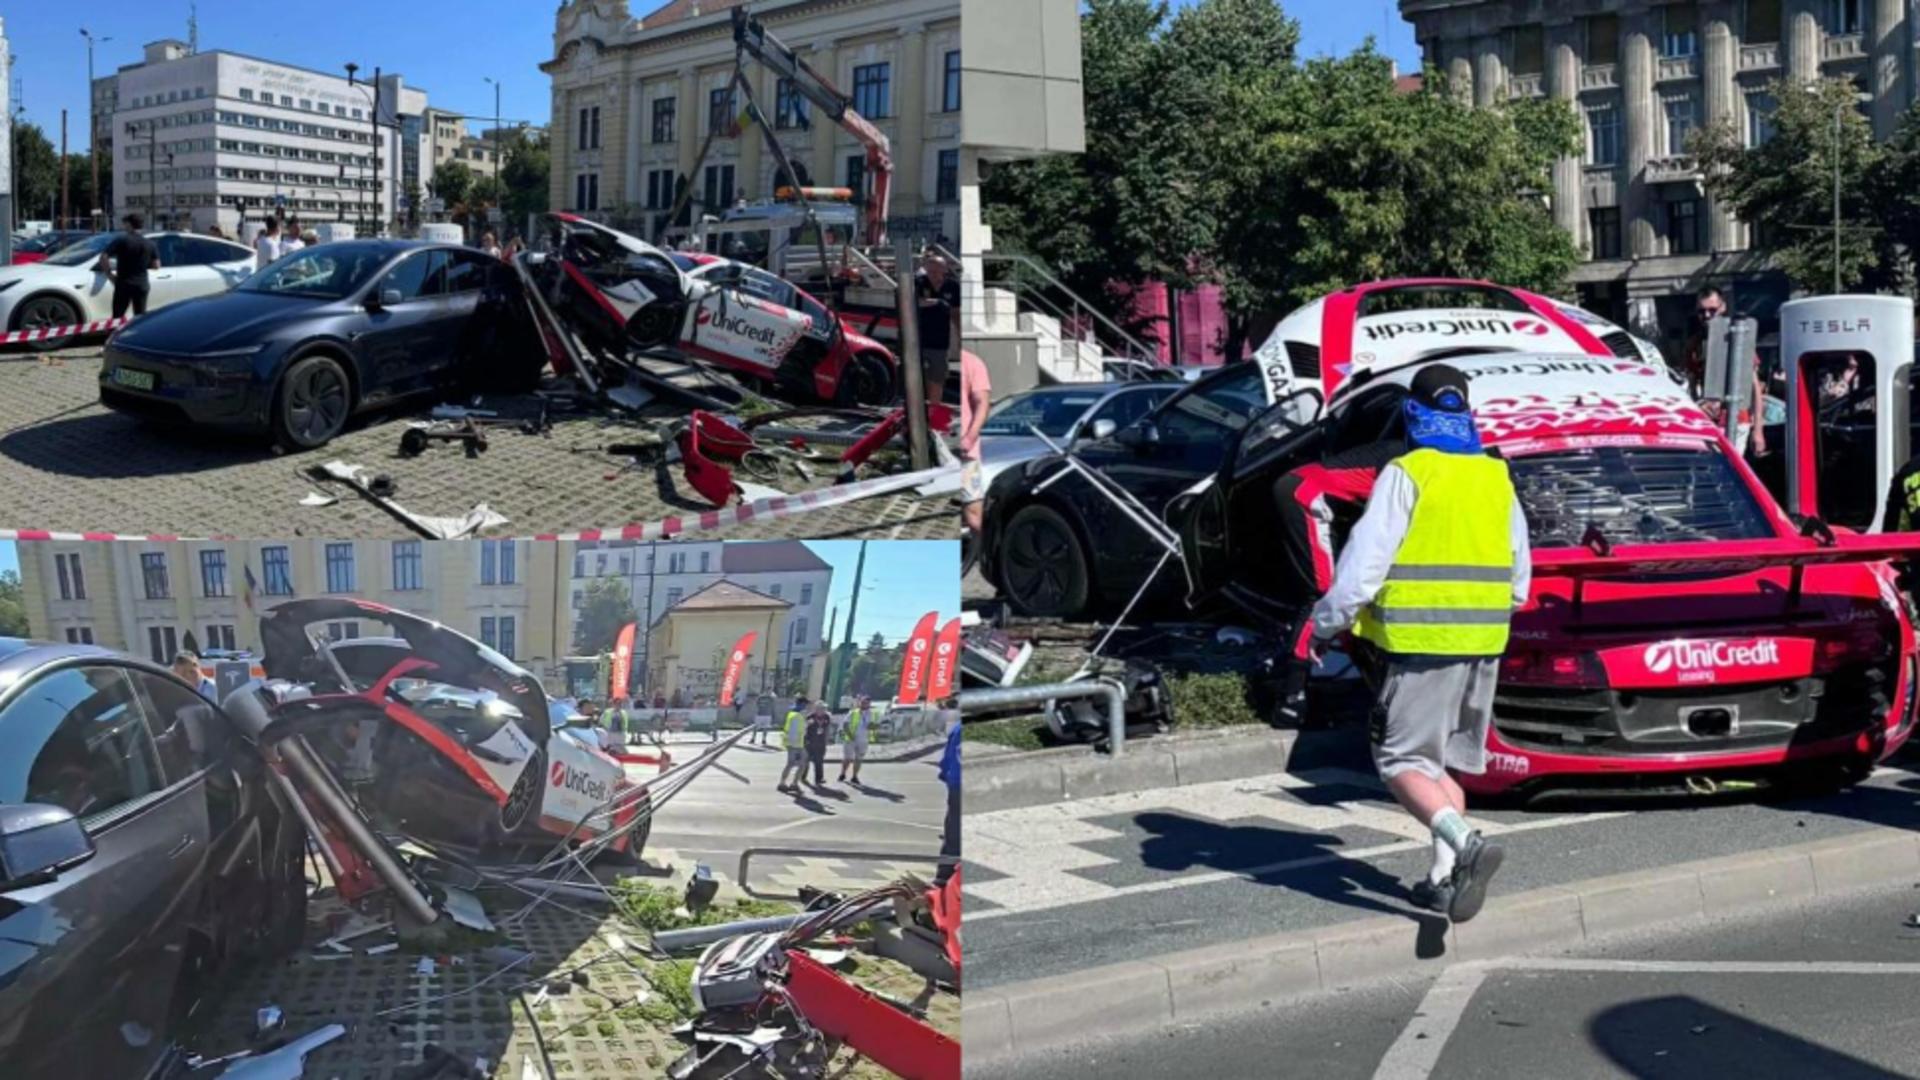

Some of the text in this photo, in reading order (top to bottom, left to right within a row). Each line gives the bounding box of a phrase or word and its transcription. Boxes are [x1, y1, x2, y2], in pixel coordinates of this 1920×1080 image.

[711, 311, 775, 345] UniCredit
[1363, 318, 1514, 341] UniCredit
[1799, 318, 1871, 333] TESLA
[1461, 362, 1613, 382] UniCred
[1674, 639, 1780, 670] UniCredit
[1677, 670, 1715, 682] Leasing
